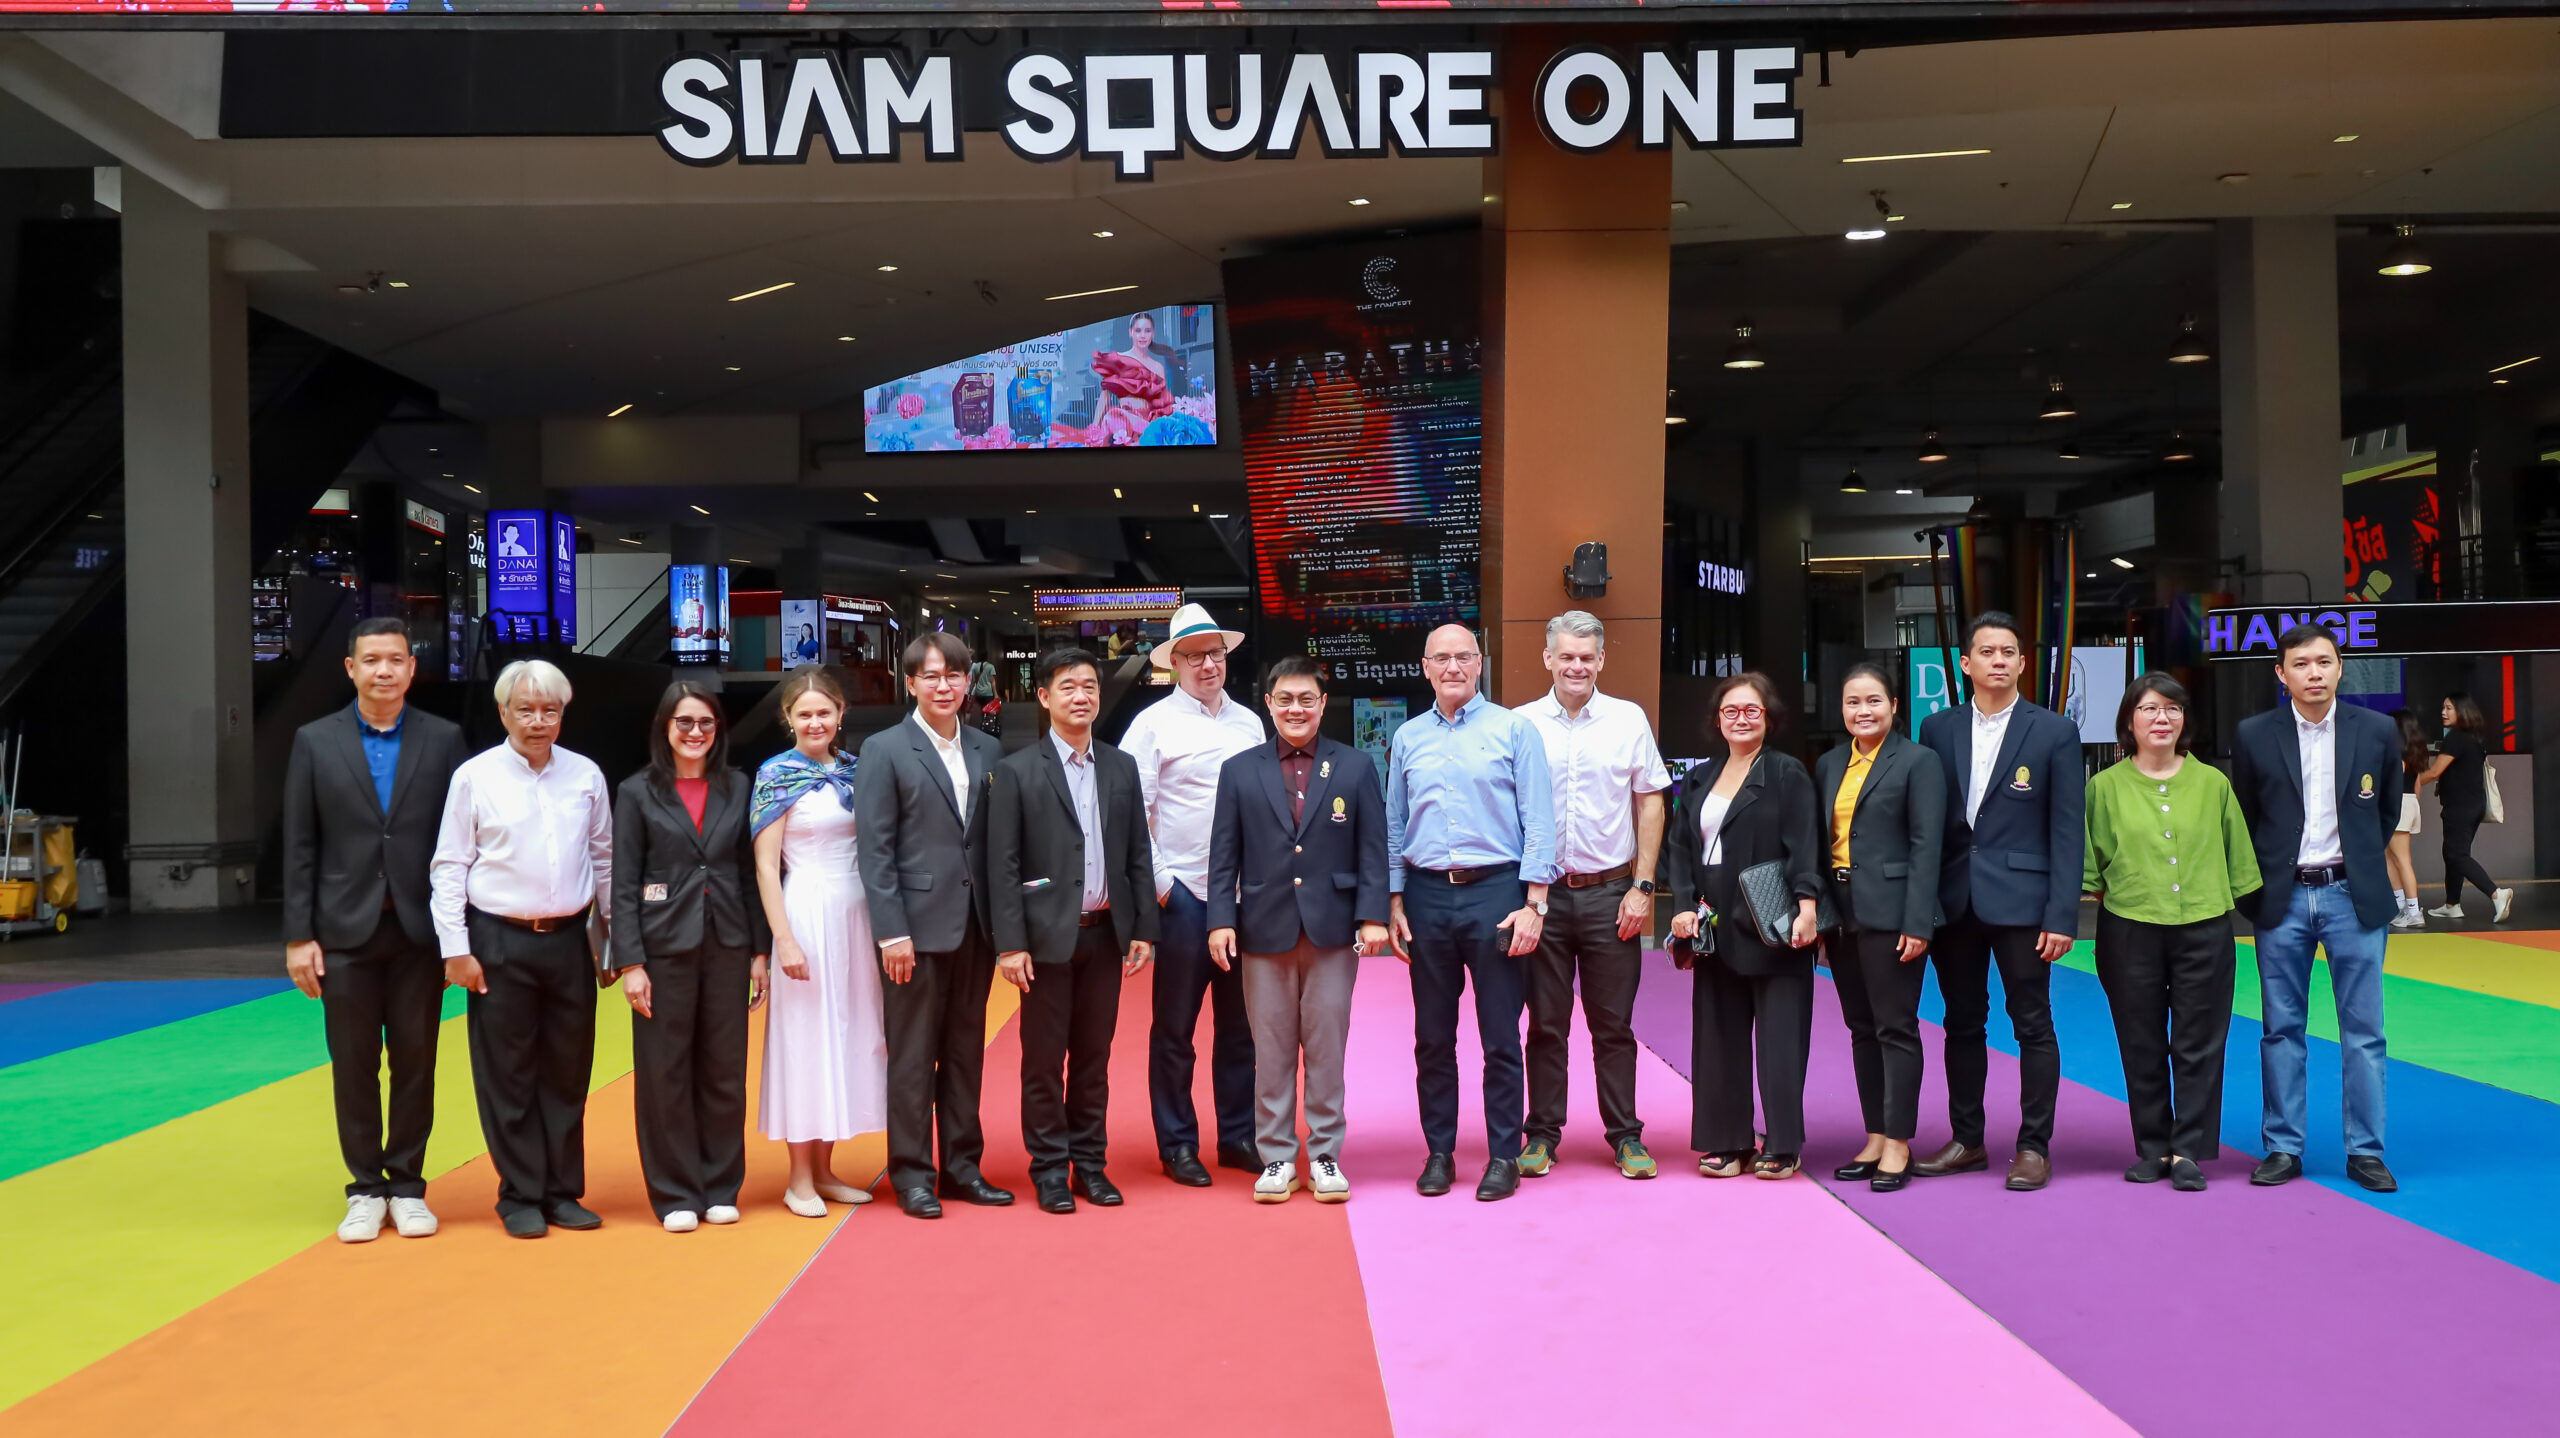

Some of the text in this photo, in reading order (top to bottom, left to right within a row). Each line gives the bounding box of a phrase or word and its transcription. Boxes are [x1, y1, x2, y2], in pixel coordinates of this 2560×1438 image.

[661, 47, 1796, 174] SIAM SQUARE ONE
[1019, 343, 1063, 354] UNISEX
[498, 559, 538, 570] DANAI
[1698, 560, 1746, 595] STARBU
[1040, 596, 1057, 604] YOUR
[1057, 595, 1081, 604] HEALTH
[1006, 650, 1026, 659] niko
[1334, 662, 1349, 680] 6
[1355, 660, 1421, 685] มิถุนาย
